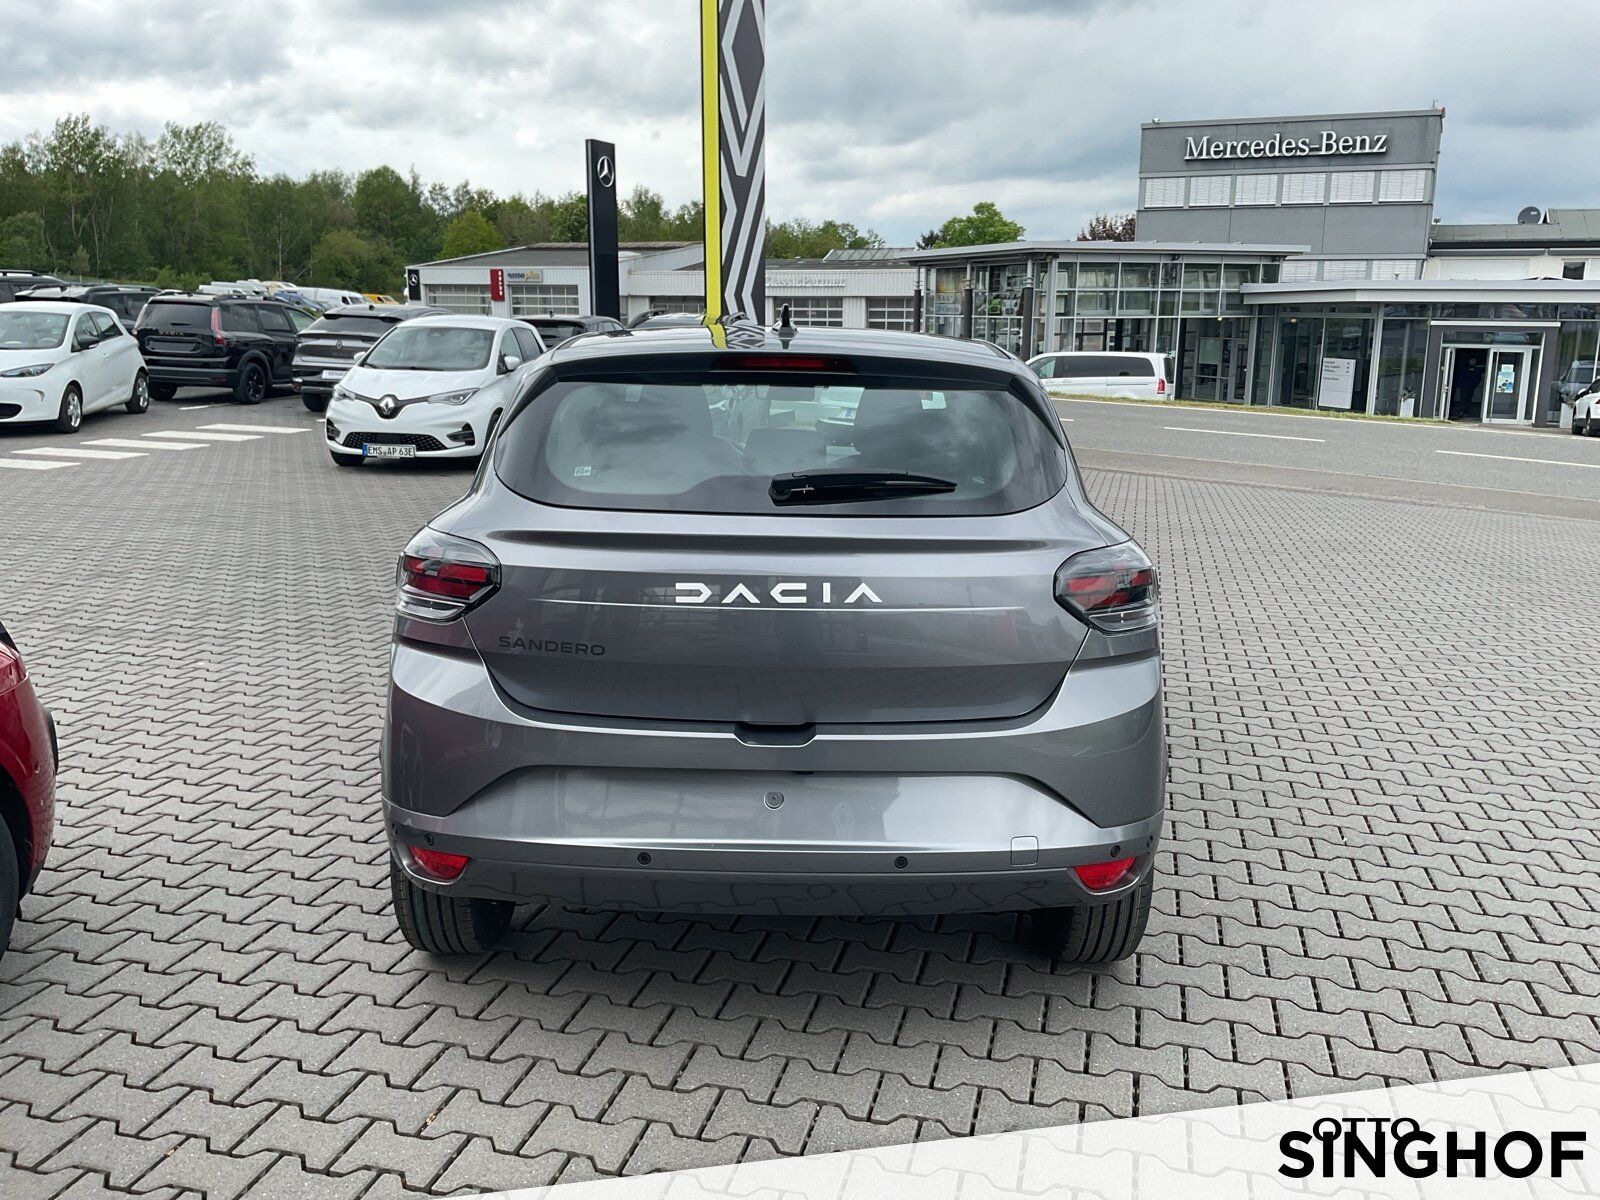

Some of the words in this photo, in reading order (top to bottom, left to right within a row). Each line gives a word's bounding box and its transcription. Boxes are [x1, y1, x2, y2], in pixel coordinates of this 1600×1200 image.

[1184, 130, 1389, 160] Mercedes-Benz
[368, 446, 383, 455] EMS
[387, 447, 397, 455] AP
[675, 582, 883, 604] DACIA
[498, 635, 606, 656] SANDERO
